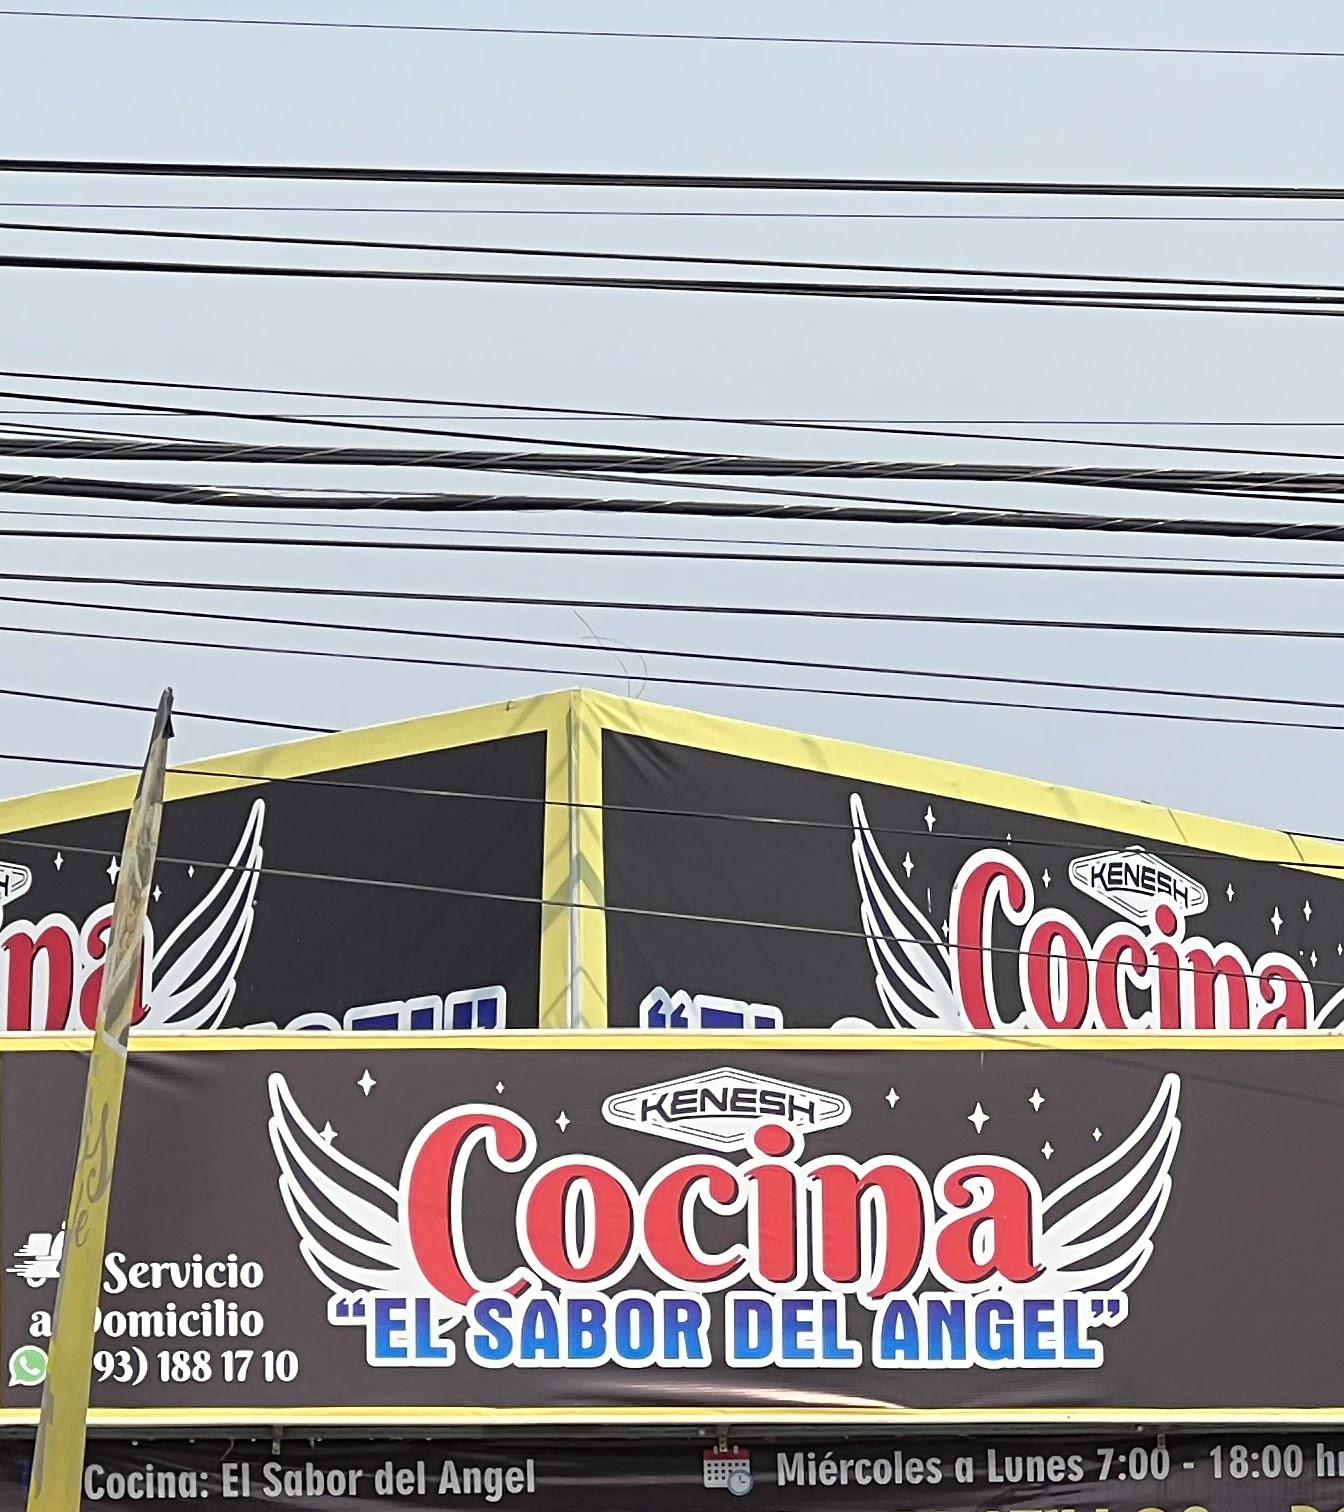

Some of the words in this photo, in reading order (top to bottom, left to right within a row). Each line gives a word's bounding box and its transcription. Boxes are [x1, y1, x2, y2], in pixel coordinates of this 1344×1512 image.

[1091, 861, 1189, 908] KENESH
[950, 859, 1313, 1030] Cocina
[641, 1090, 816, 1126] KENESH
[407, 1111, 1045, 1303] Cocina
[103, 1251, 264, 1294] Servicio
[29, 1310, 52, 1337] a
[93, 1299, 264, 1338] omicilio
[471, 1295, 704, 1361] SABOR
[726, 1295, 856, 1361] DEL
[93, 1346, 148, 1386] 93)
[157, 1350, 212, 1383] 188
[221, 1350, 254, 1382] 17
[261, 1350, 299, 1382] 10
[85, 1464, 208, 1499] Cocina:
[223, 1463, 250, 1497] El
[263, 1461, 365, 1497] Sabor
[375, 1461, 426, 1495] del
[438, 1459, 534, 1502] Angel
[777, 1451, 942, 1485] Miércoles
[954, 1457, 973, 1483] a
[988, 1448, 1083, 1483] Lunes
[1097, 1446, 1170, 1480] 7:00
[1209, 1445, 1304, 1478] 18:00
